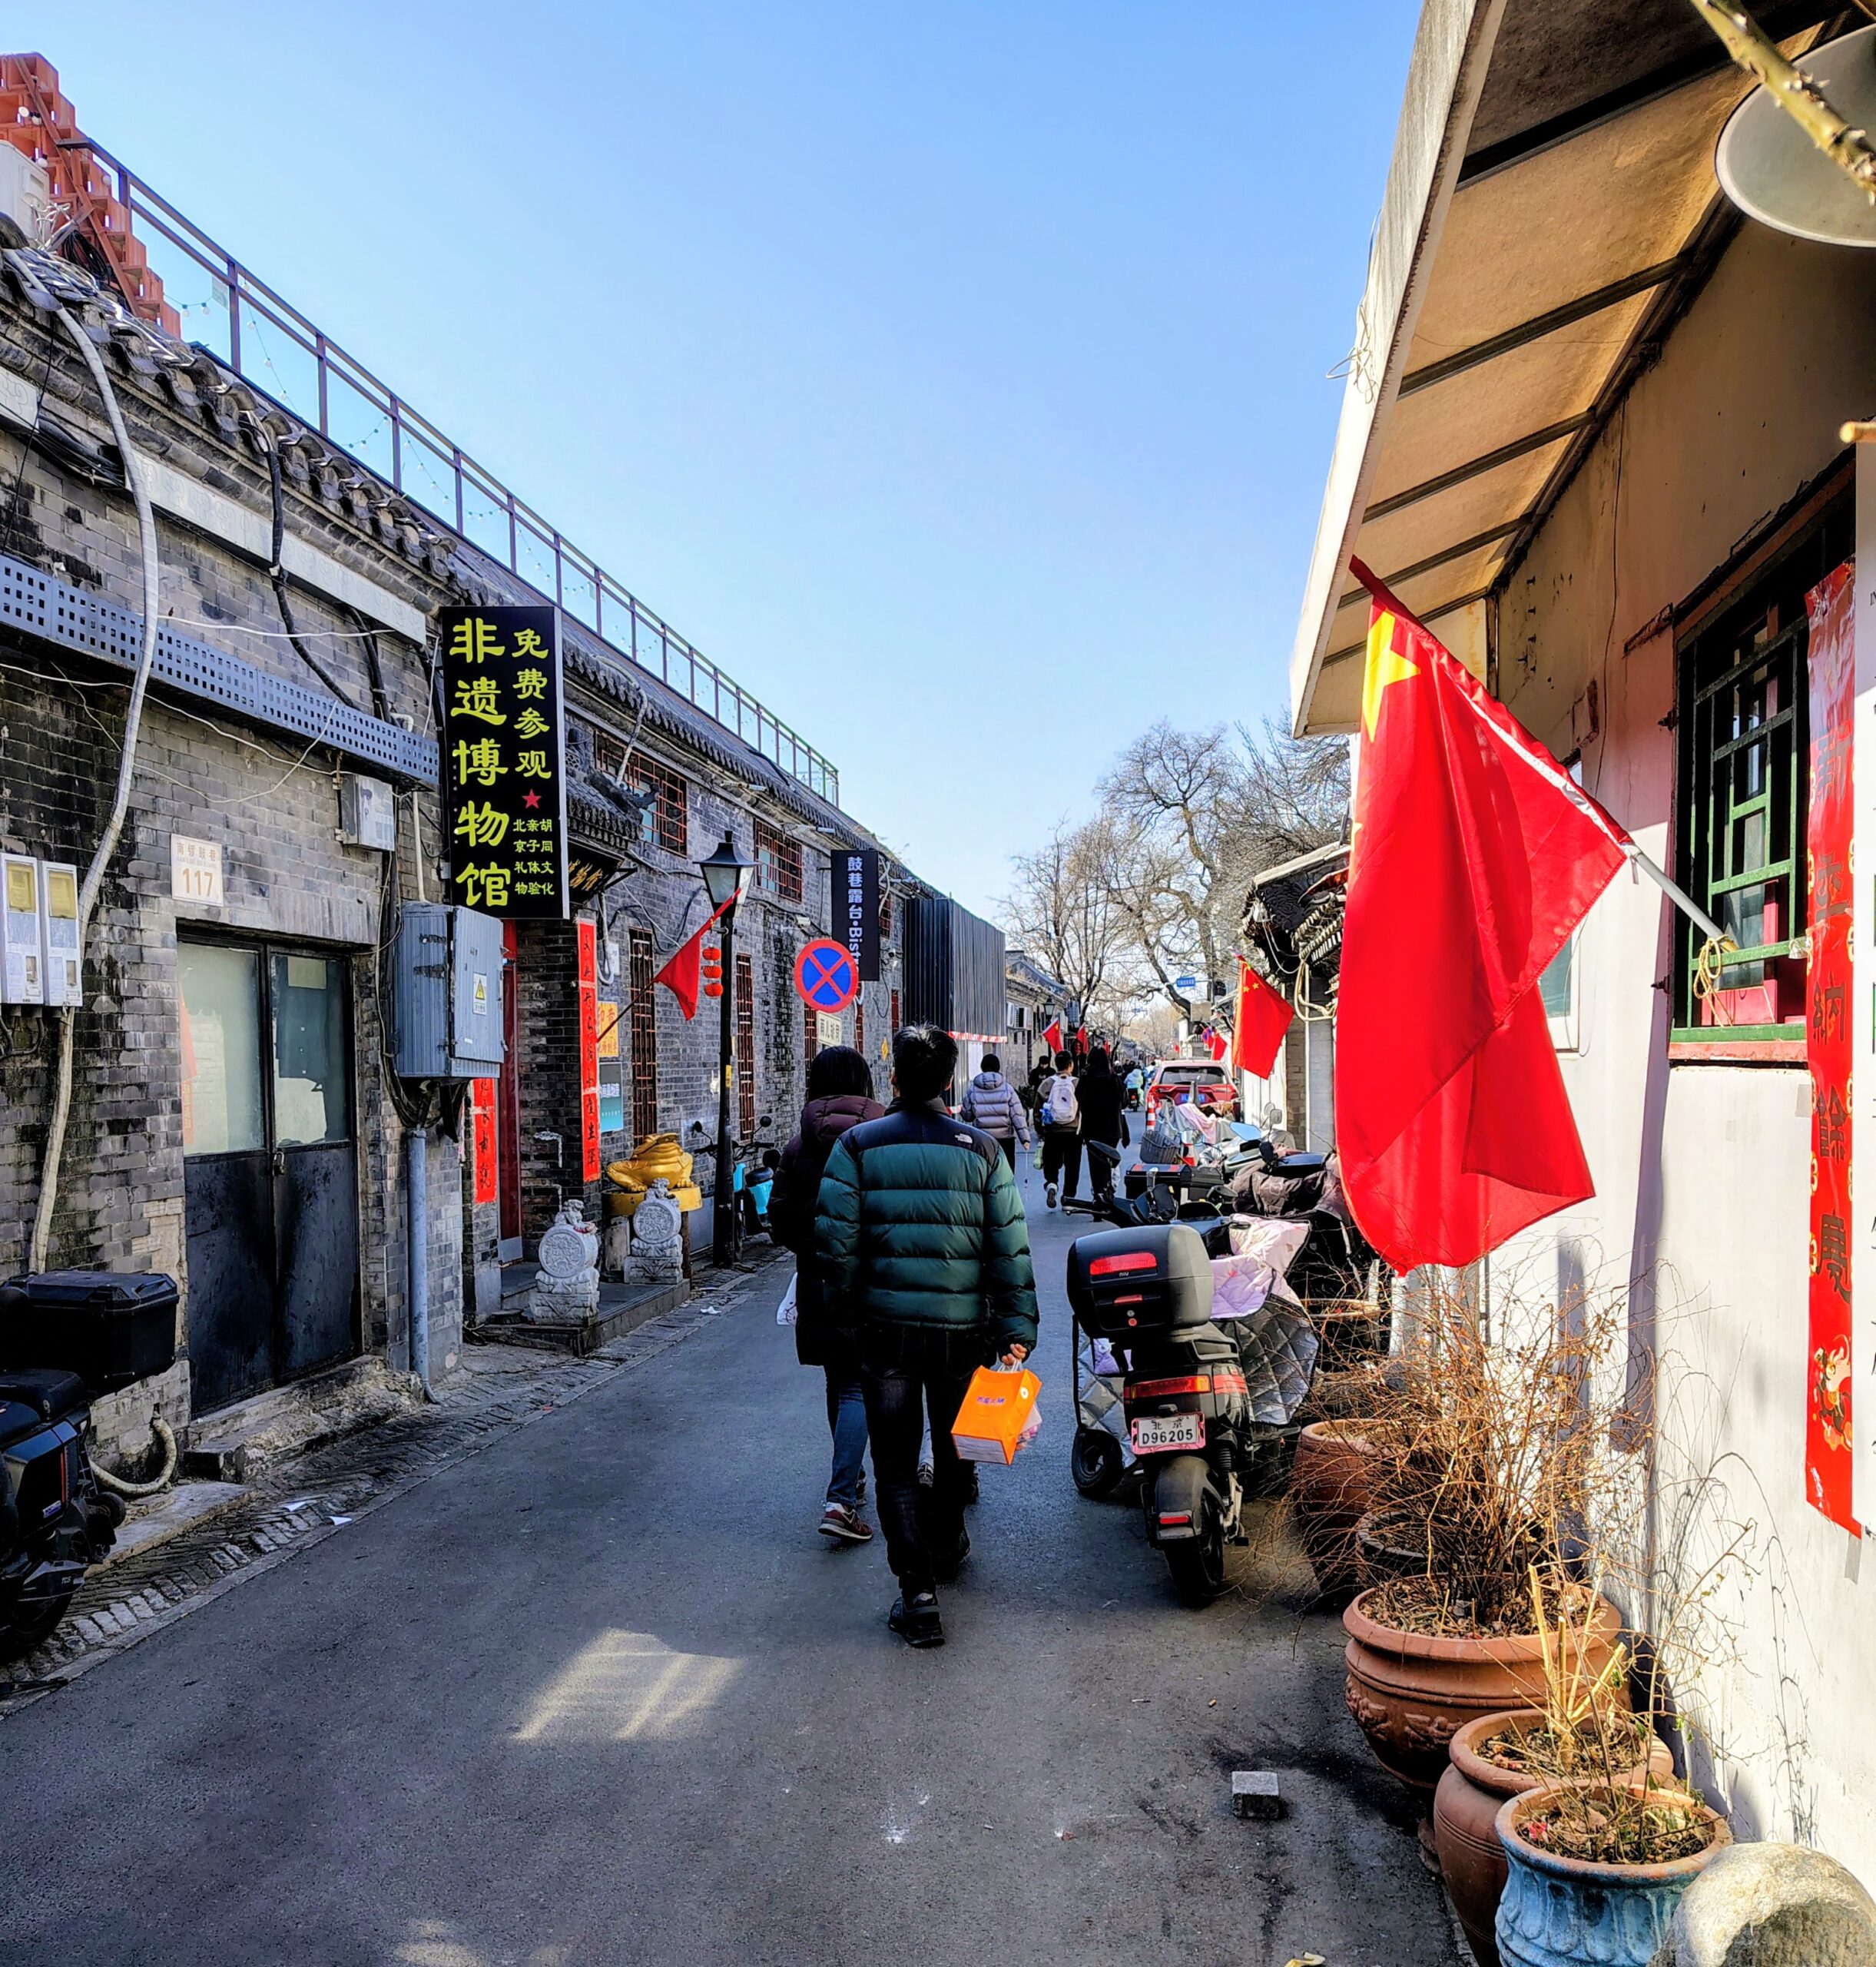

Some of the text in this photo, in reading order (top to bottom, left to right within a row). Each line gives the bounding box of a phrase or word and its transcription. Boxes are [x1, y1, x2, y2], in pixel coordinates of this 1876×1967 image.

[512, 628, 552, 779] 免费参观
[449, 618, 511, 907] 非遗博物馆
[183, 868, 213, 897] 117
[1142, 1428, 1194, 1445] D96205
